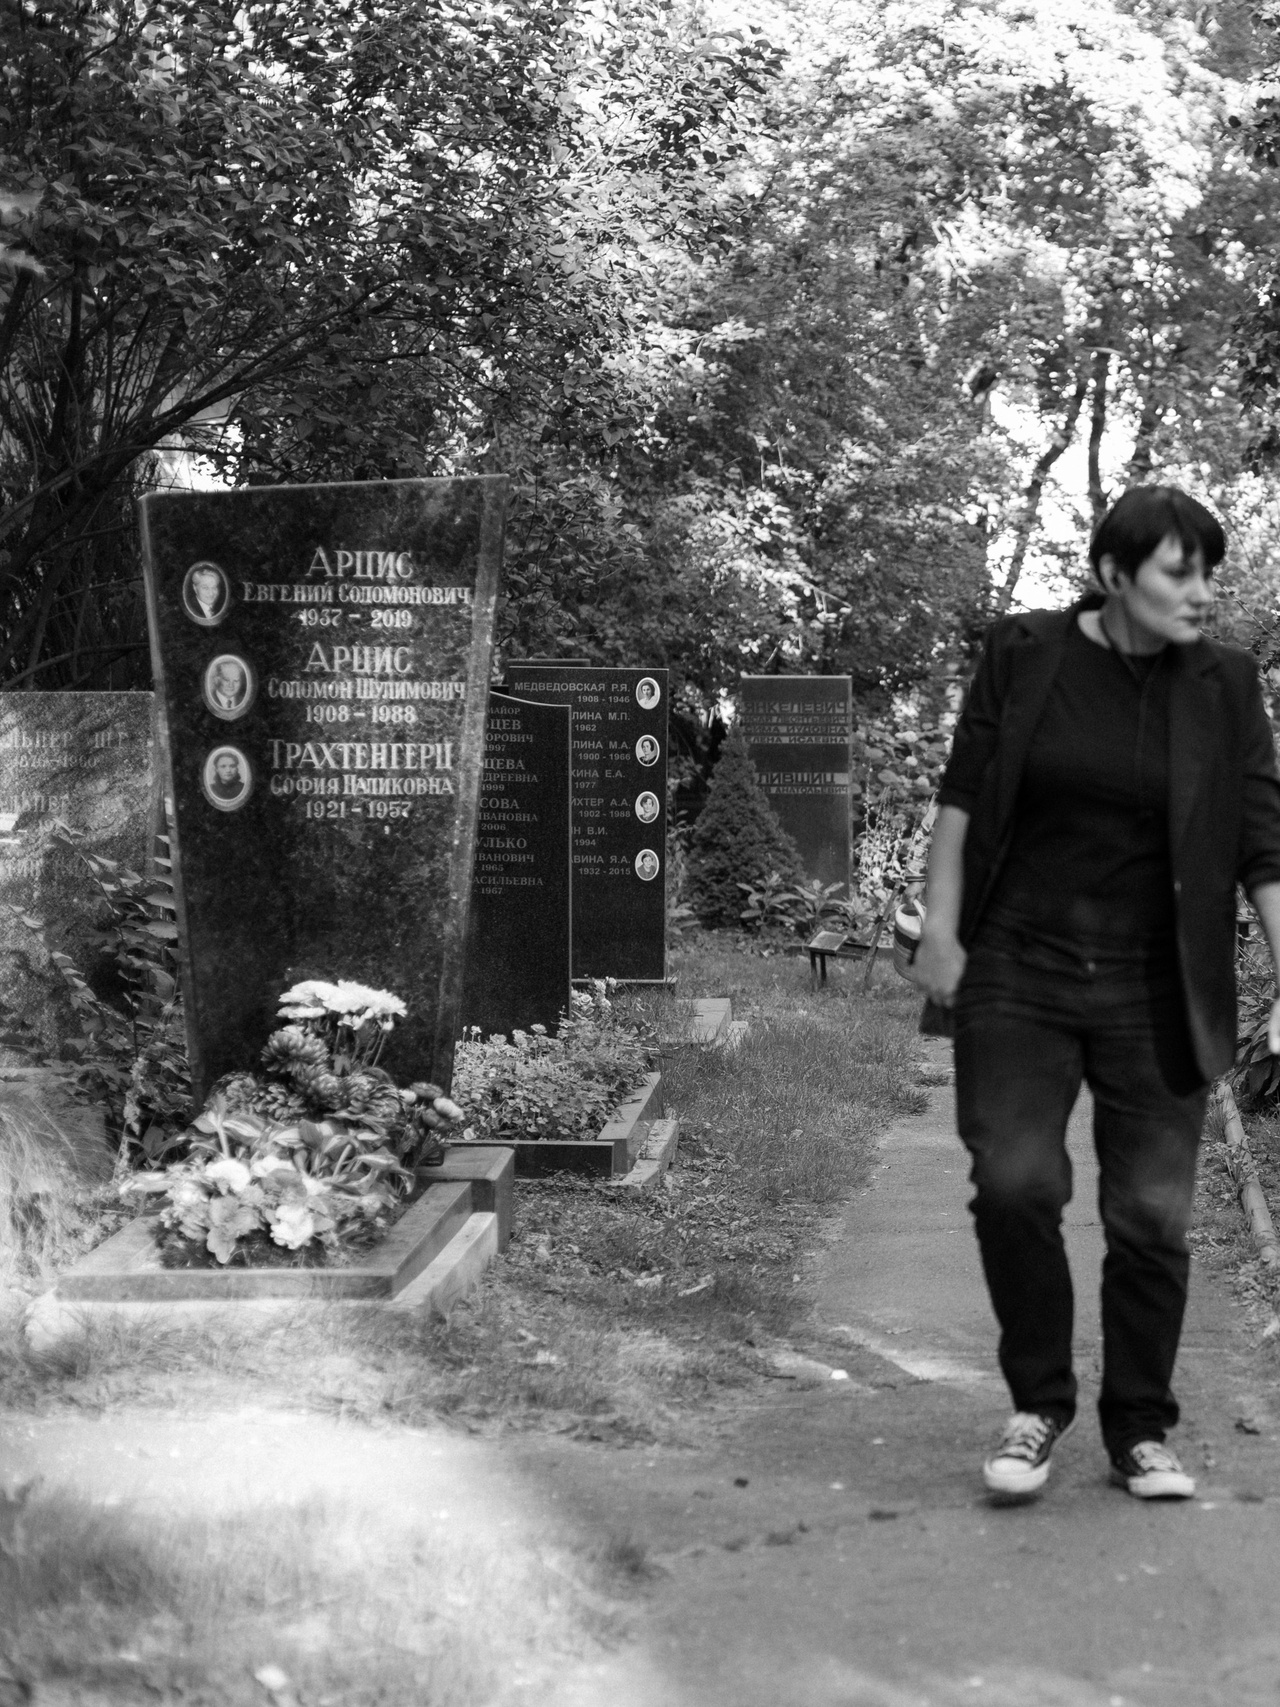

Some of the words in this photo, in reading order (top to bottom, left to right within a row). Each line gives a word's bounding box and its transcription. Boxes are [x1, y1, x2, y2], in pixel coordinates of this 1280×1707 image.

[305, 546, 413, 580] АРЦИС
[242, 581, 335, 603] ЕВГЕНИЙ
[338, 583, 471, 605] СОЛОМОНОВИЧ
[300, 609, 342, 627] 1937
[370, 609, 412, 628] 2019
[302, 641, 412, 675] АРЦИС
[268, 678, 352, 699] СОЛОМОН
[355, 678, 466, 700] ШУЛИМОВИЧ
[514, 682, 605, 692] МЕДВЕДОВСКАЯ
[611, 683, 630, 692] Р.Я.
[577, 695, 599, 703] 1908
[305, 705, 350, 723] 1908
[371, 705, 418, 724] 1988
[575, 724, 597, 732] 1962
[267, 739, 453, 771] ТРАХТЕНГЕРЦ
[270, 774, 339, 796] СОФИЯ
[481, 773, 538, 783] ДРЕЕВНА
[758, 773, 834, 784] ЛИВШИЦ
[305, 801, 346, 819] 1921
[366, 801, 412, 819] 1957
